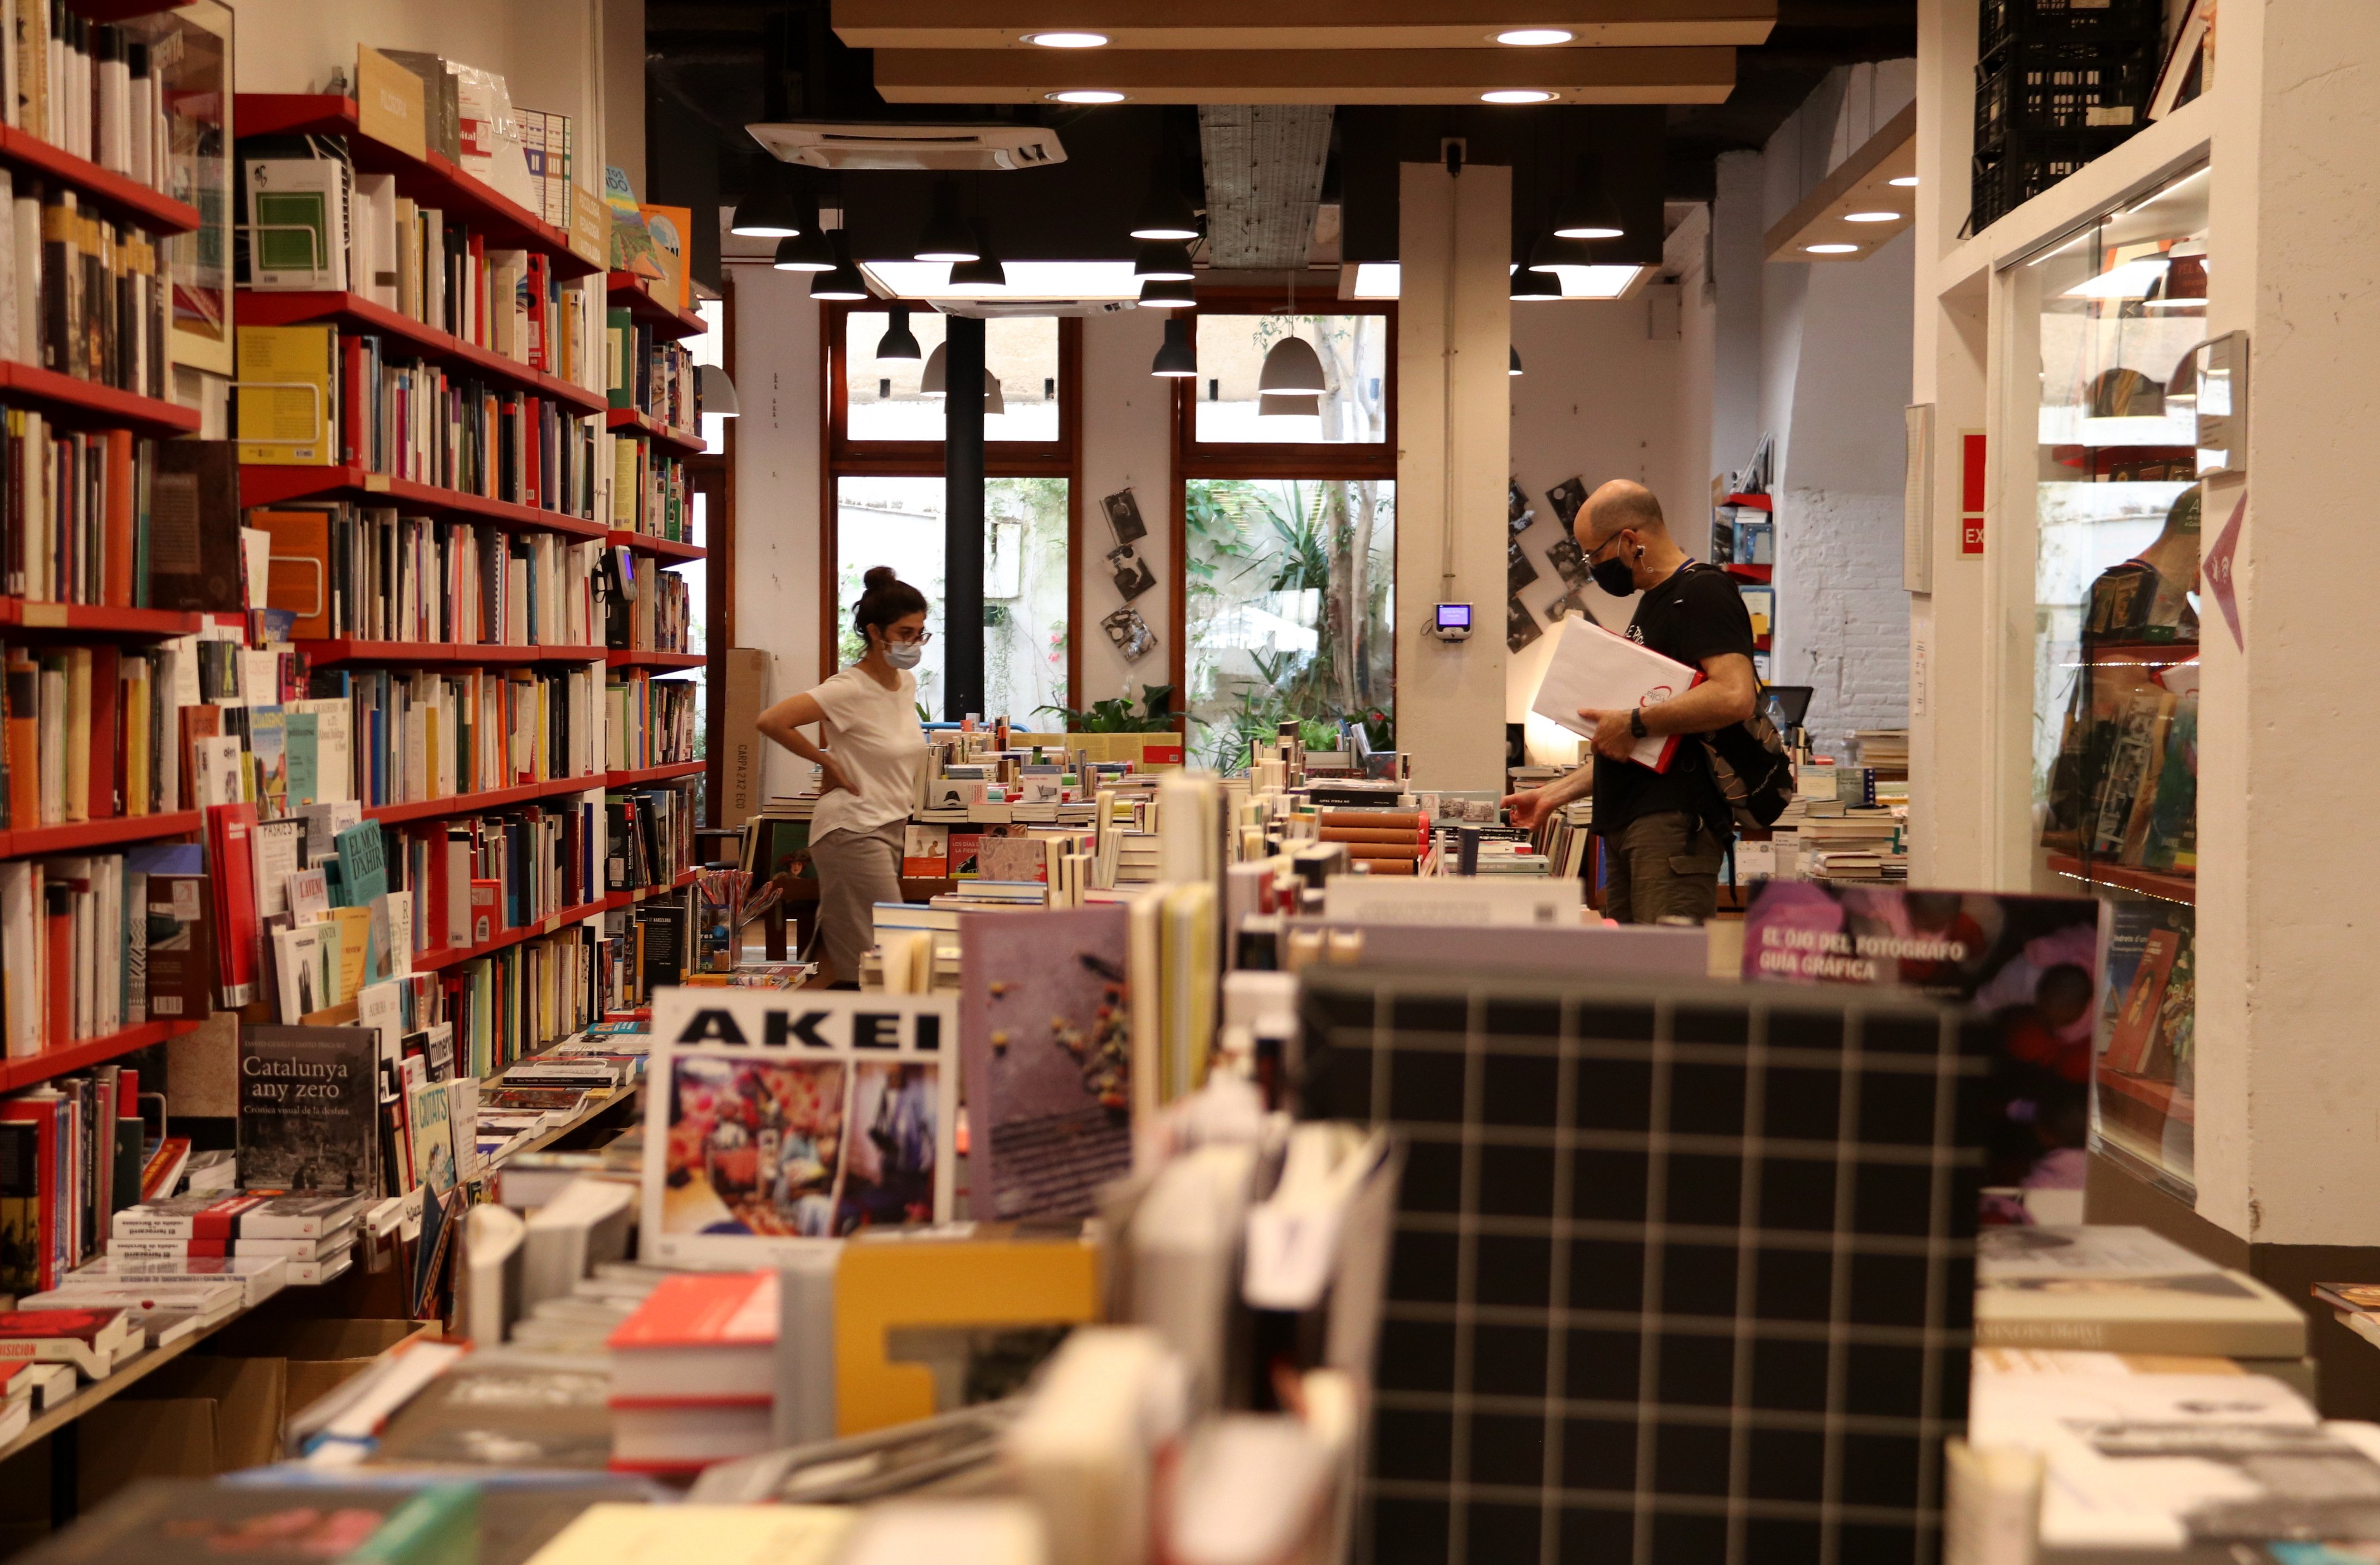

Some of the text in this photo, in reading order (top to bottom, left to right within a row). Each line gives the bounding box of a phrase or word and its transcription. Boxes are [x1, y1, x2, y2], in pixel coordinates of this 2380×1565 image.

[738, 745, 747, 771] CARPA
[735, 793, 745, 809] ECO
[349, 822, 381, 858] EL MÓN
[352, 848, 382, 881] D'AHIR
[1762, 926, 1780, 946] EL
[1785, 928, 1813, 950] OJO
[1819, 932, 1850, 952] DEL
[676, 1009, 940, 1050] AKEI
[431, 1035, 452, 1063] minerva
[243, 1056, 348, 1082] Catalunya
[252, 1083, 339, 1102] any zero
[278, 1105, 300, 1114] visual
[321, 1106, 349, 1115] desfeta
[419, 1088, 447, 1129] CIUTATS
